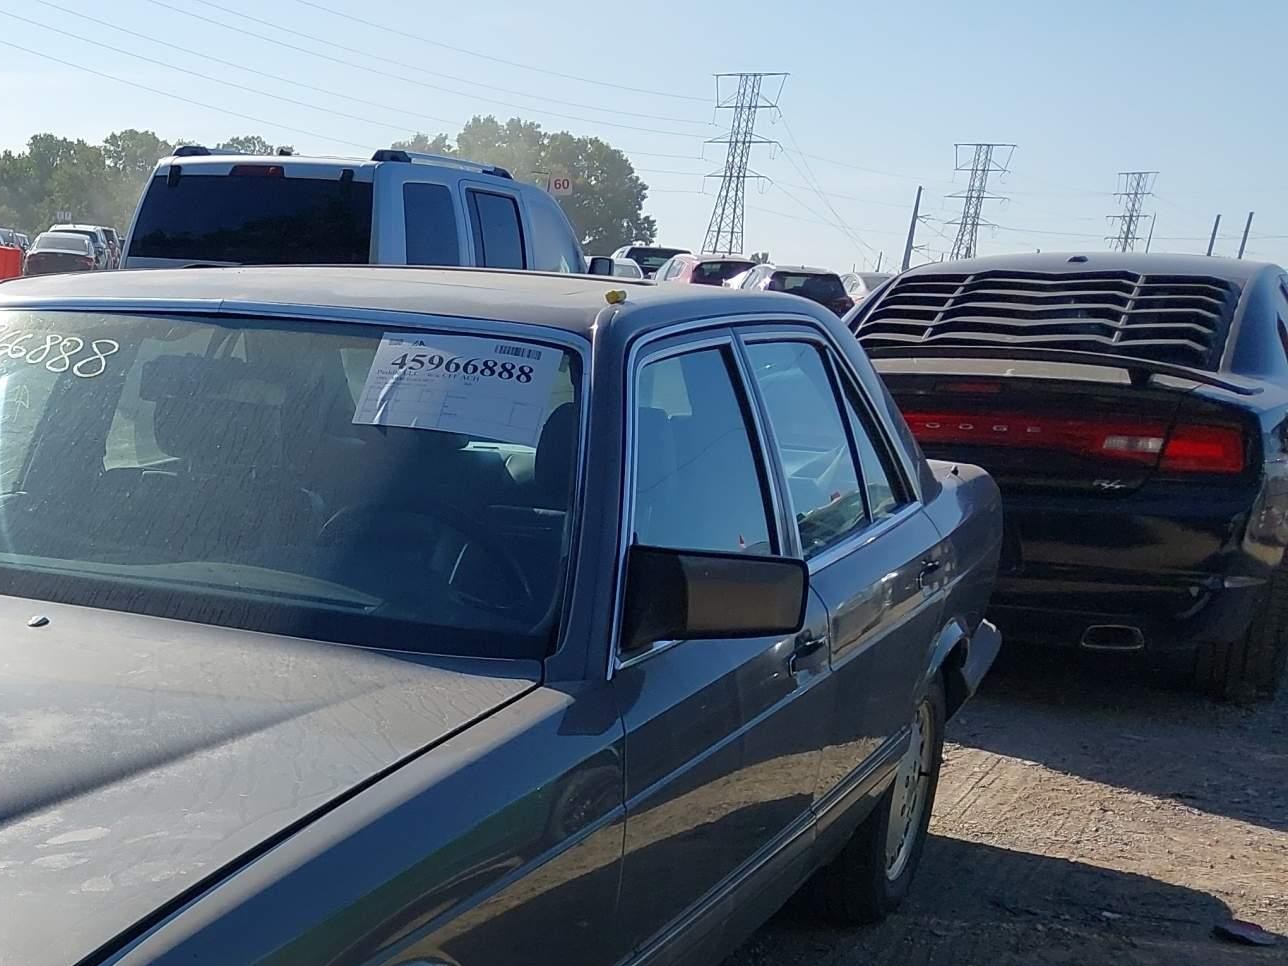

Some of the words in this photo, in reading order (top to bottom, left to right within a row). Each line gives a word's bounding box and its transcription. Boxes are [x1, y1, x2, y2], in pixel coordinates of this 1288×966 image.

[554, 179, 570, 190] 60
[391, 353, 535, 384] 45966888
[924, 421, 1042, 434] ODGE
